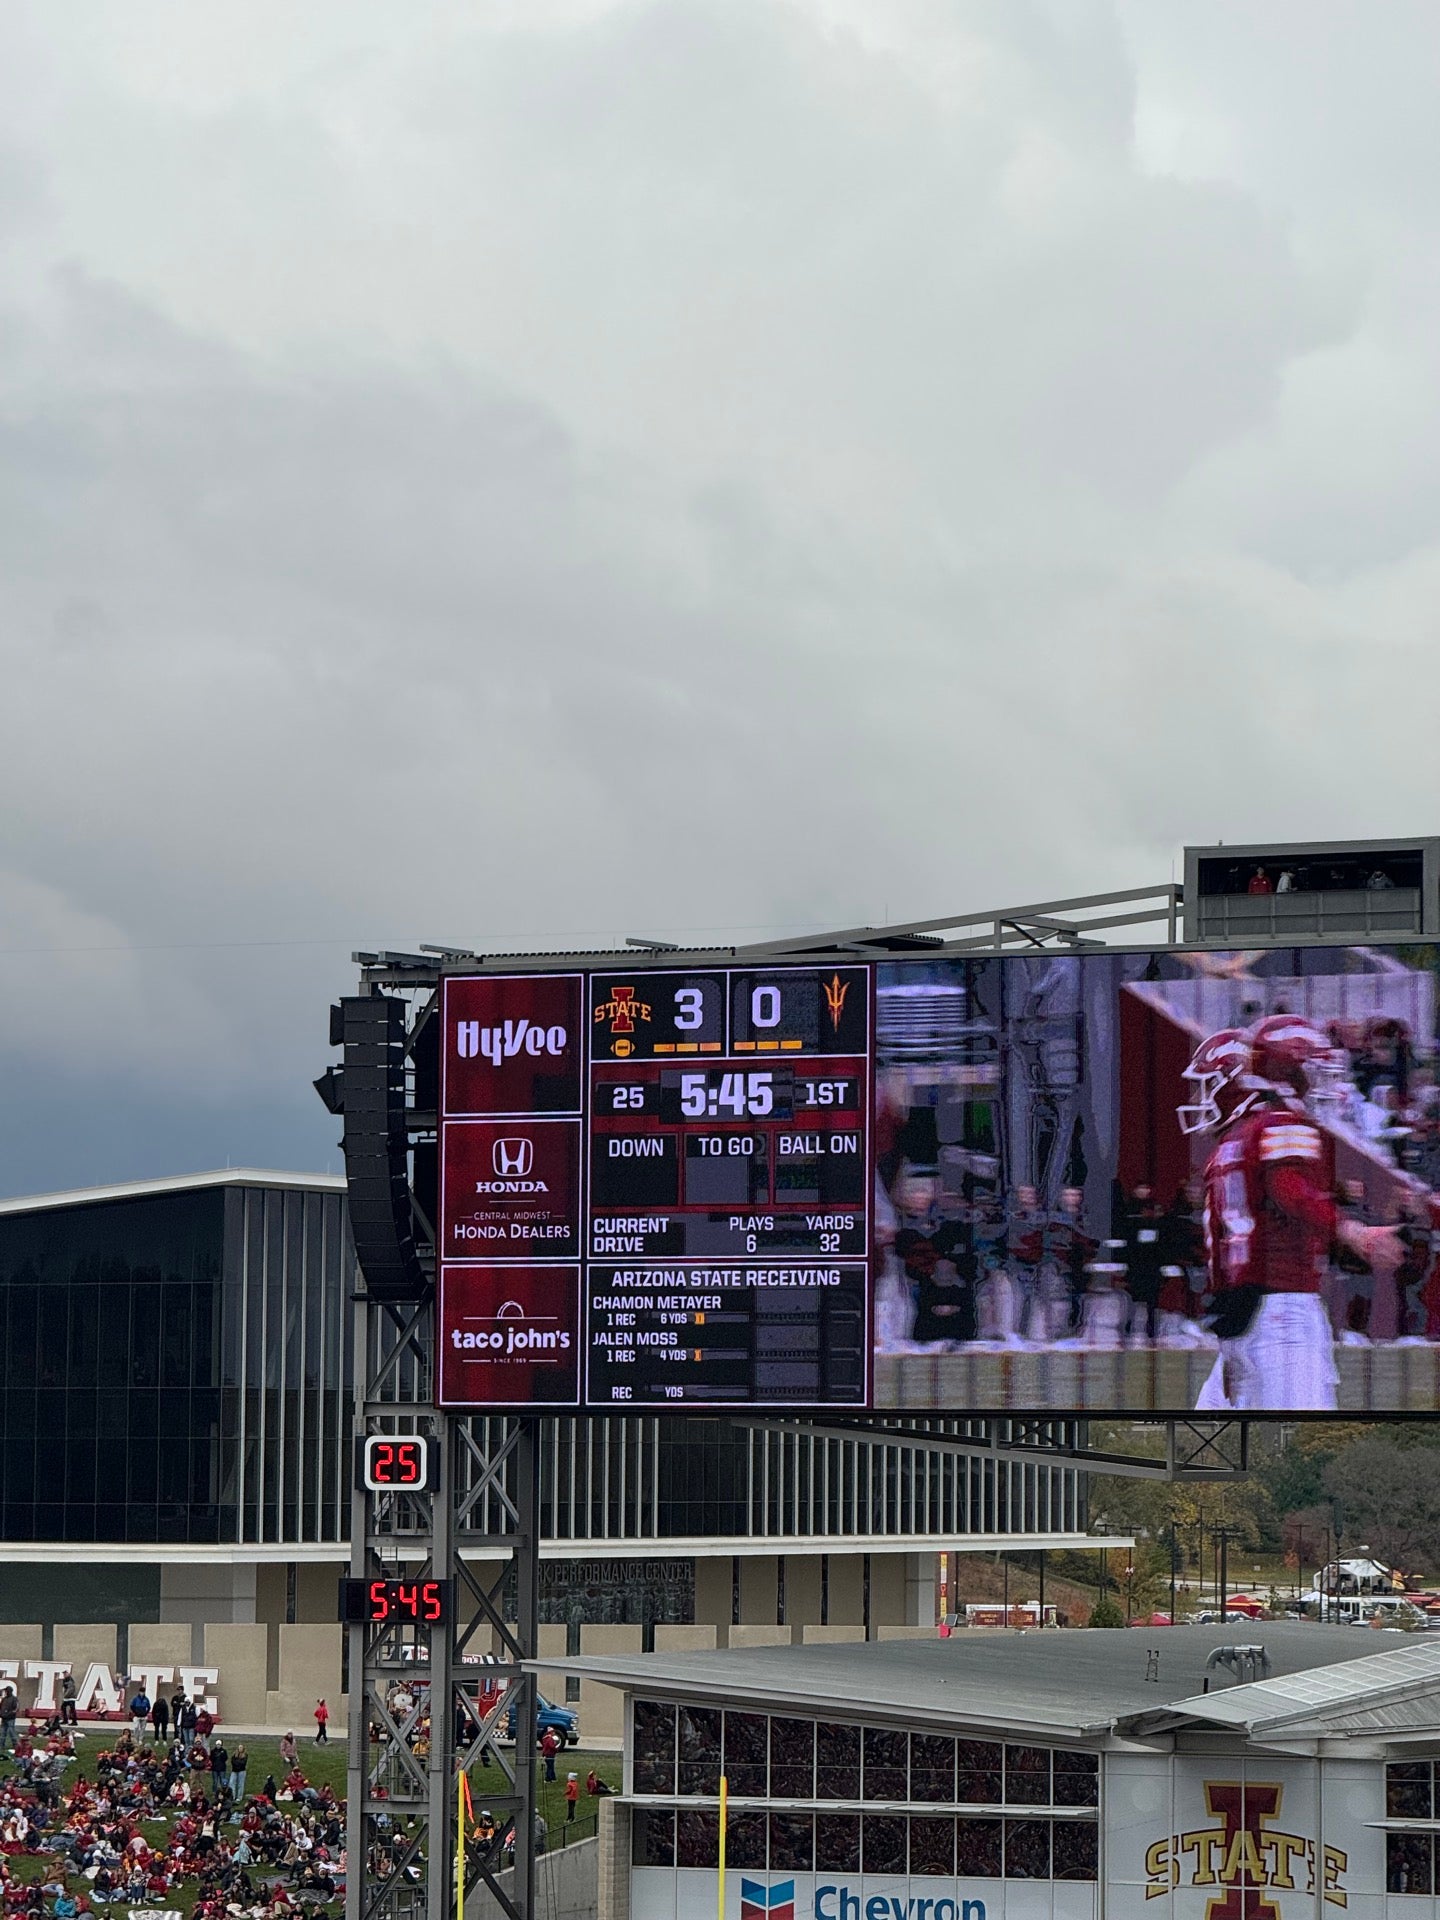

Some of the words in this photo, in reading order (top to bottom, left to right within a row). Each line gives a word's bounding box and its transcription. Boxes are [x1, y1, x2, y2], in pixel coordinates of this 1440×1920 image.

[594, 1001, 652, 1023] STATE
[675, 989, 702, 1029] 3
[752, 987, 780, 1027] 0
[614, 1087, 643, 1108] 25
[682, 1073, 772, 1115] 5:45
[806, 1083, 848, 1104] 1ST
[609, 1139, 663, 1156] DOWN
[699, 1138, 721, 1155] TO
[729, 1138, 753, 1155] GO
[780, 1136, 825, 1154] BALL
[831, 1136, 856, 1153] ON
[475, 1181, 549, 1193] HONDA
[473, 1211, 511, 1221] CENTRAL
[513, 1211, 551, 1220] MIDWEST
[729, 1217, 774, 1230] PLAYS
[805, 1216, 854, 1229] YARDS
[454, 1225, 507, 1238] HONDA
[510, 1224, 571, 1238] DEALERS
[594, 1218, 669, 1233] CURRENT
[594, 1237, 643, 1252] DRIVE
[747, 1235, 756, 1252] 6
[820, 1234, 839, 1251] 32
[612, 1271, 686, 1286] ARIZONA
[691, 1271, 741, 1286] STATE
[746, 1270, 840, 1285] RECEIVING
[593, 1297, 654, 1309] CHAMON
[657, 1296, 722, 1308] METAYER
[607, 1314, 614, 1325] 1
[615, 1314, 636, 1325] REC
[660, 1312, 668, 1324] 6
[668, 1312, 688, 1324] YDS
[452, 1330, 503, 1348] taco
[507, 1328, 569, 1353] john's
[592, 1333, 633, 1345] JALEN
[636, 1333, 678, 1345] MOSS
[607, 1350, 613, 1362] 1
[615, 1350, 636, 1362] REC
[659, 1349, 667, 1361] 4
[668, 1349, 687, 1361] YDS
[611, 1387, 632, 1398] REC
[664, 1386, 684, 1398] YDS
[375, 1445, 416, 1482] 25
[554, 1562, 643, 1588] PERFORMANCE
[645, 1561, 693, 1586] CENTER
[370, 1582, 441, 1619] 5:45
[1145, 1828, 1348, 1908] STATE
[815, 1886, 986, 1920] Chevron
